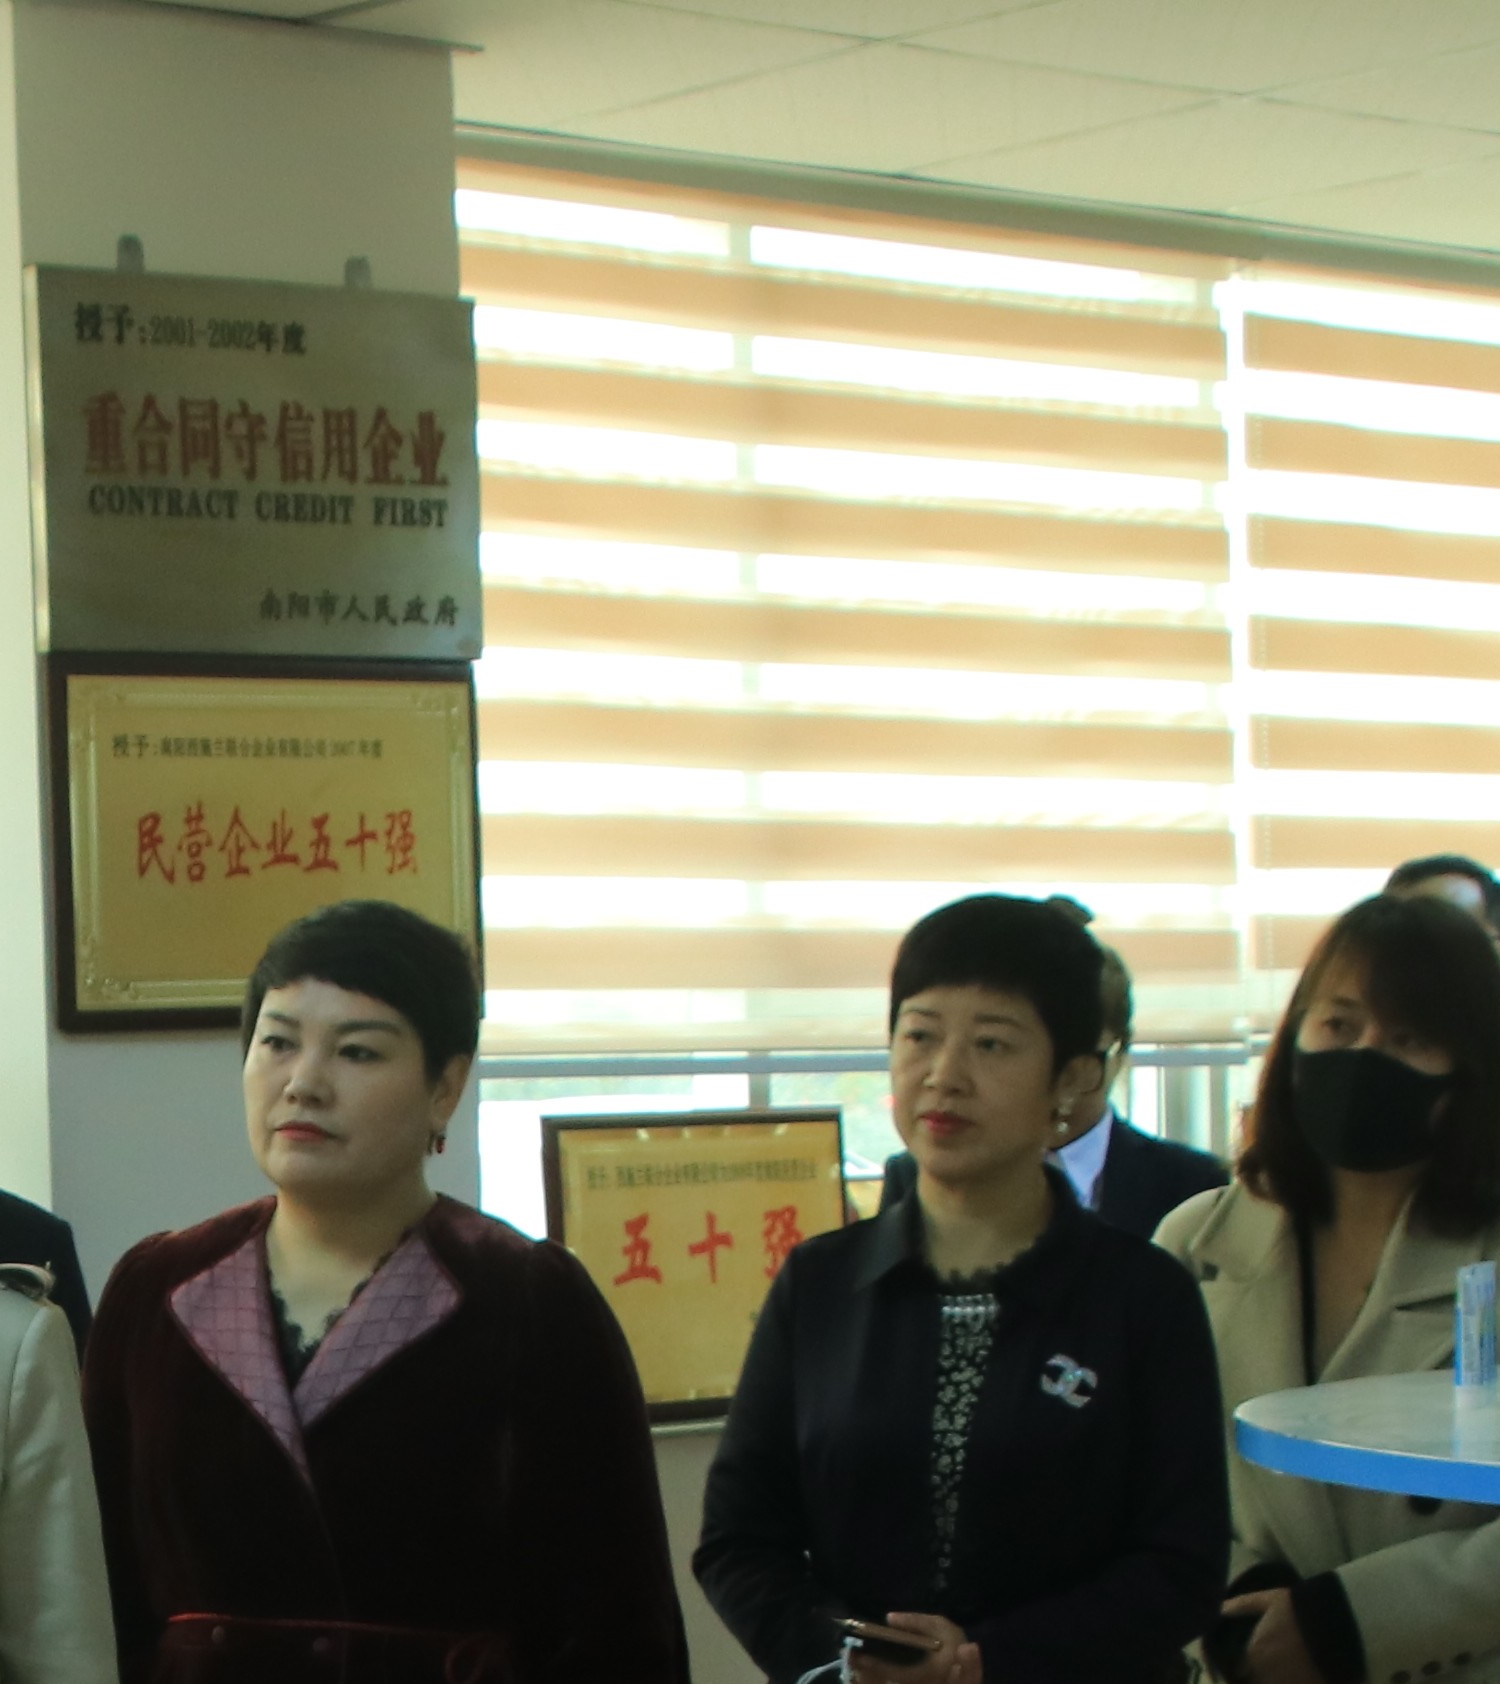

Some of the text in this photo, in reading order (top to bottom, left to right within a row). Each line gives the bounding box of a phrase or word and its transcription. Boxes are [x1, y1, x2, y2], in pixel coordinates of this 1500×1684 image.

[85, 391, 450, 488] 重合同守信用企业
[89, 485, 449, 528] CONTRACT CREDIT FIRST
[260, 589, 459, 627] 南阳市人民政府
[137, 798, 418, 886] 民营企业五十强
[614, 1205, 806, 1287] 五十强
